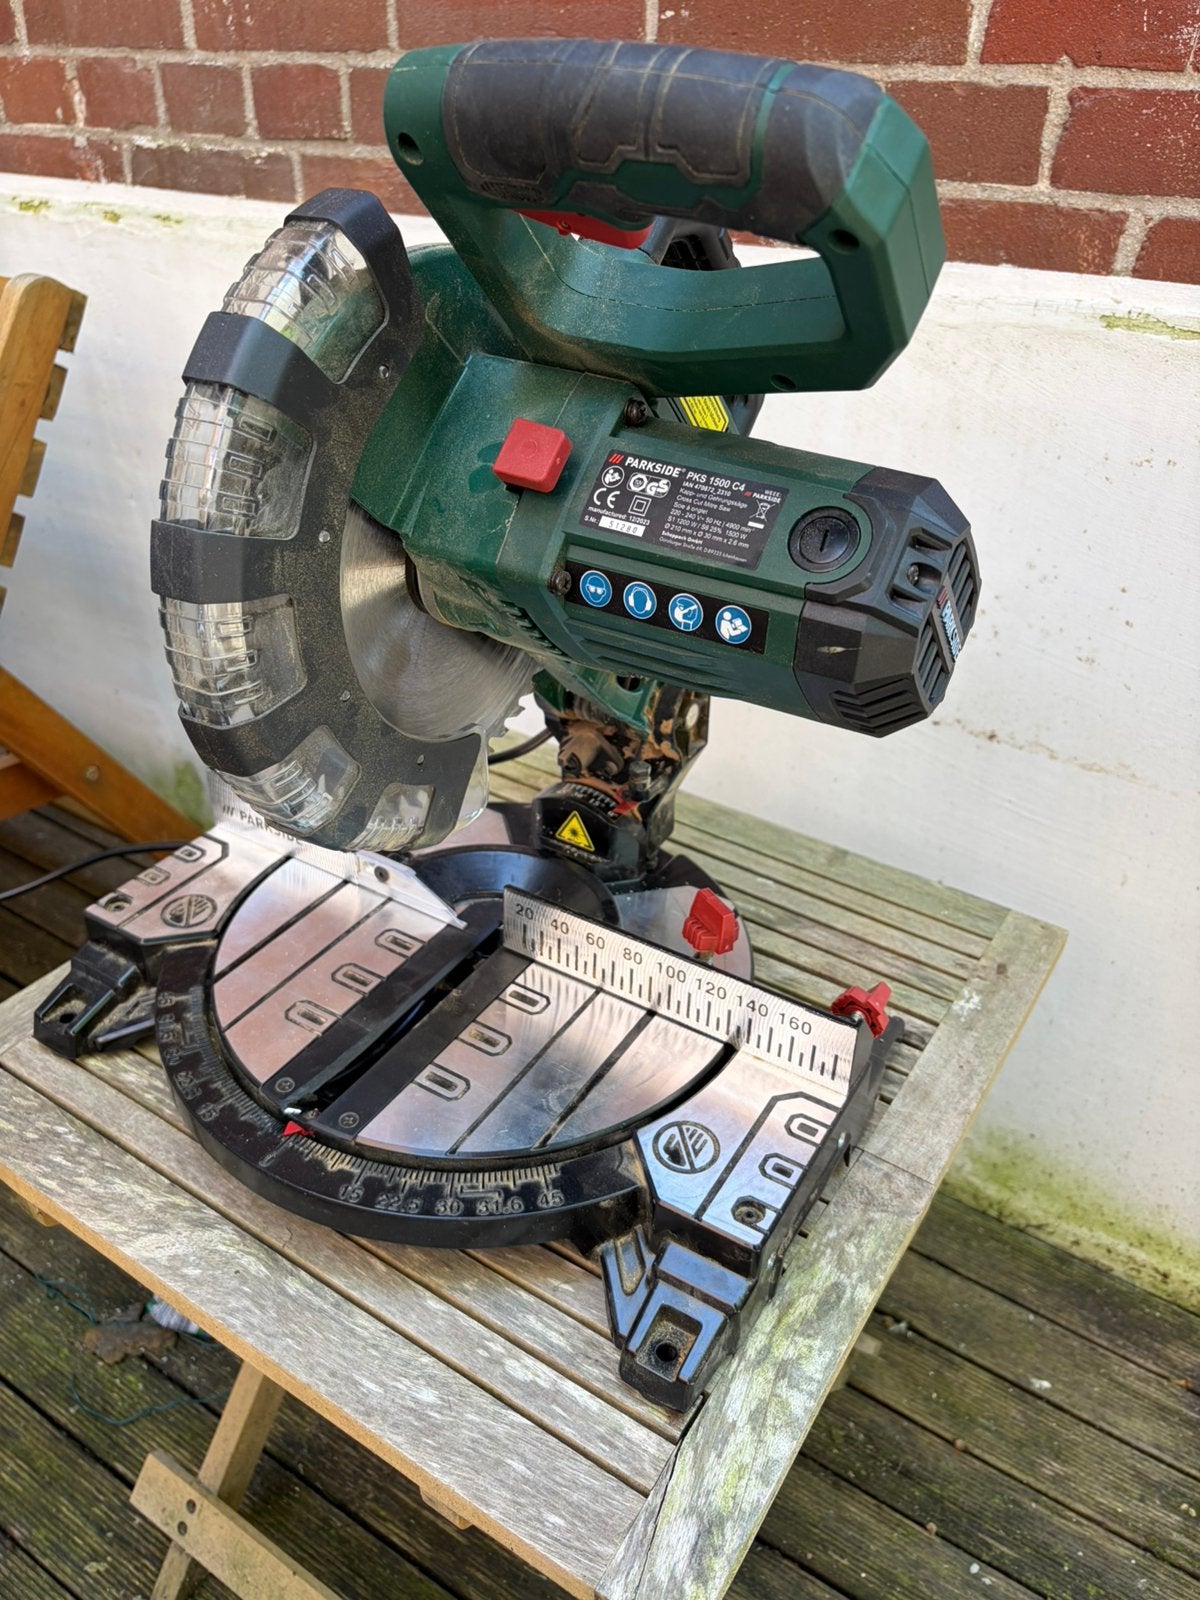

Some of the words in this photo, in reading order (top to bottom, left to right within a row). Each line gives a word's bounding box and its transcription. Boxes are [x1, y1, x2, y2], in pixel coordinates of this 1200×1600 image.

[686, 471, 707, 483] PKS
[709, 476, 731, 488] 1500
[732, 482, 746, 491] C4
[676, 495, 692, 503] Cross
[693, 498, 703, 506] Cut
[703, 501, 718, 509] Mitre
[680, 487, 695, 496] Kapp-
[708, 494, 748, 509] Gehrungssäge
[752, 492, 781, 503] PARKSIDE
[588, 506, 627, 519] manufactured:
[629, 515, 650, 526] 12/2023
[673, 501, 686, 509] Scie
[691, 507, 708, 515] onglet
[670, 508, 681, 516] 220
[725, 522, 740, 530] 4900
[709, 525, 722, 534] 25%
[726, 530, 739, 538] 1500
[515, 903, 534, 920] 20
[550, 919, 569, 935] 40
[585, 932, 606, 949] 60
[622, 947, 643, 965] 80
[657, 962, 686, 983] 100
[696, 978, 727, 1000] 120
[736, 995, 769, 1017] 140
[778, 1012, 812, 1035] 160
[340, 1184, 364, 1203] 15
[374, 1192, 421, 1214] 22.5
[538, 1189, 564, 1209] 45
[434, 1198, 463, 1216] 30
[476, 1196, 524, 1216] 31.6
